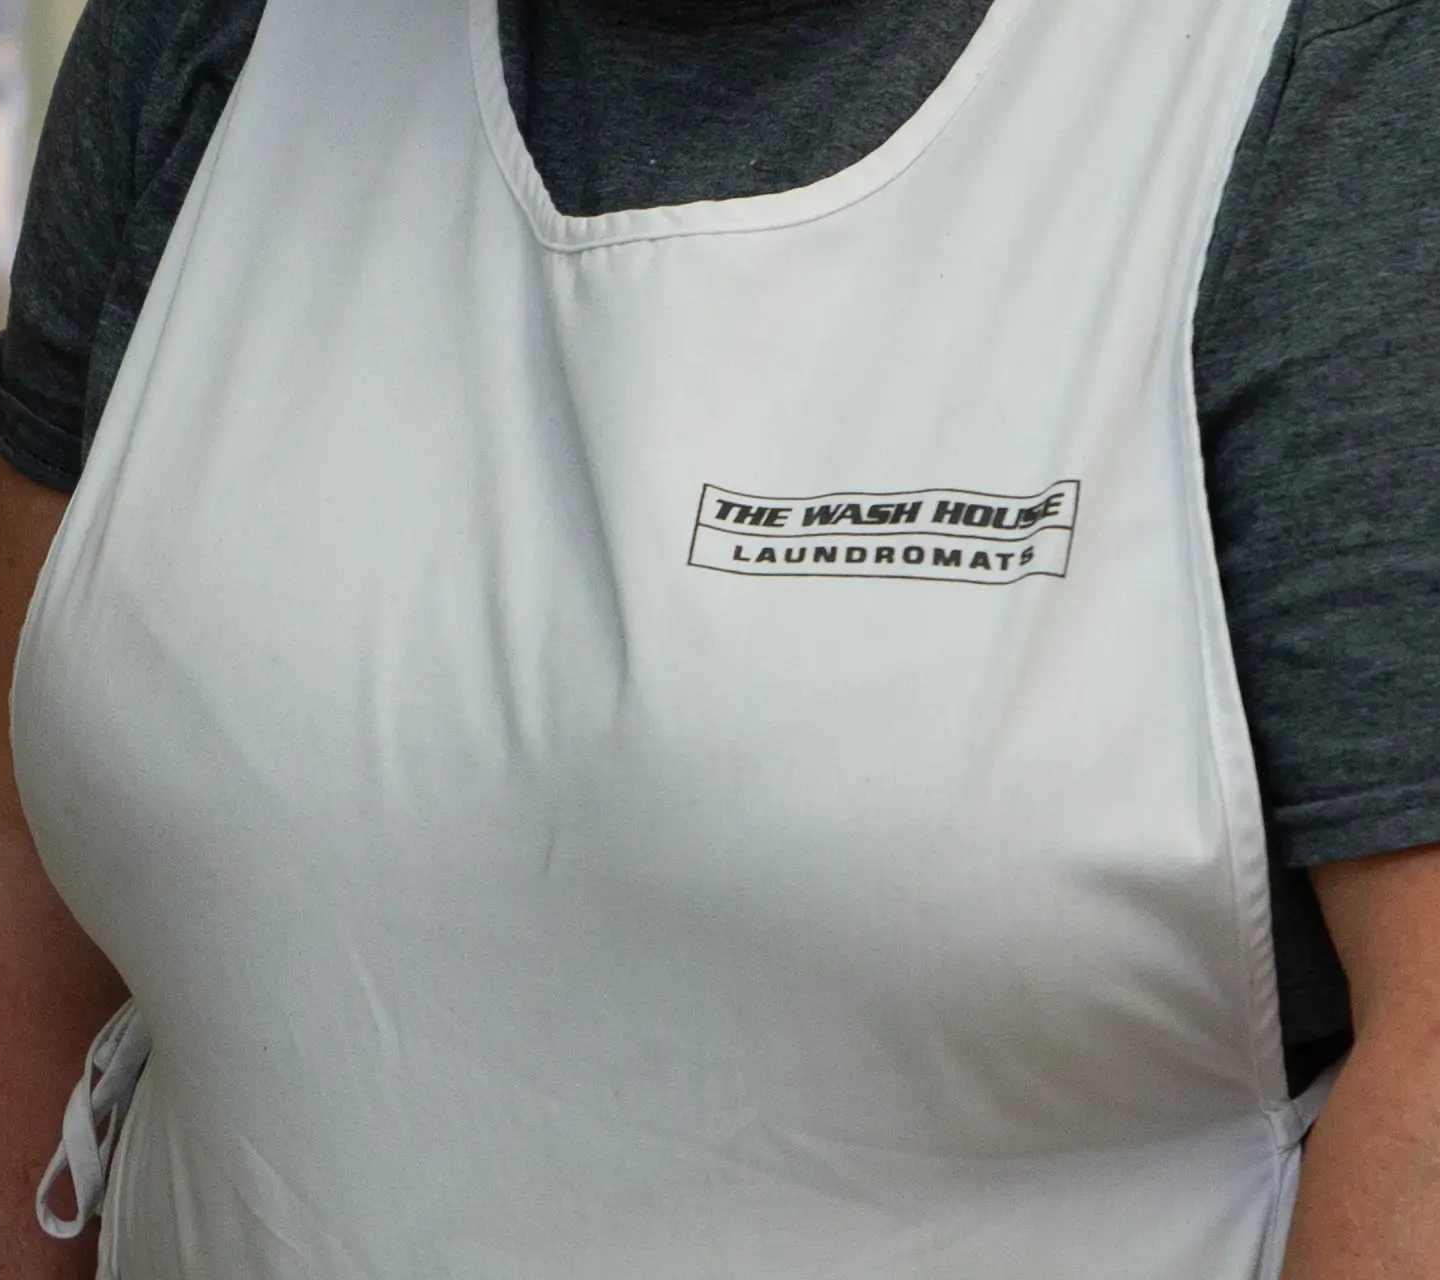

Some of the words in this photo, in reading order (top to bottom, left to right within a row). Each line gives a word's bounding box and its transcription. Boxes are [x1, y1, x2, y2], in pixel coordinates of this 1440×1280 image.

[714, 498, 793, 527] THE
[802, 500, 923, 527] WASH
[732, 544, 1035, 571] LAUNDROMATS
